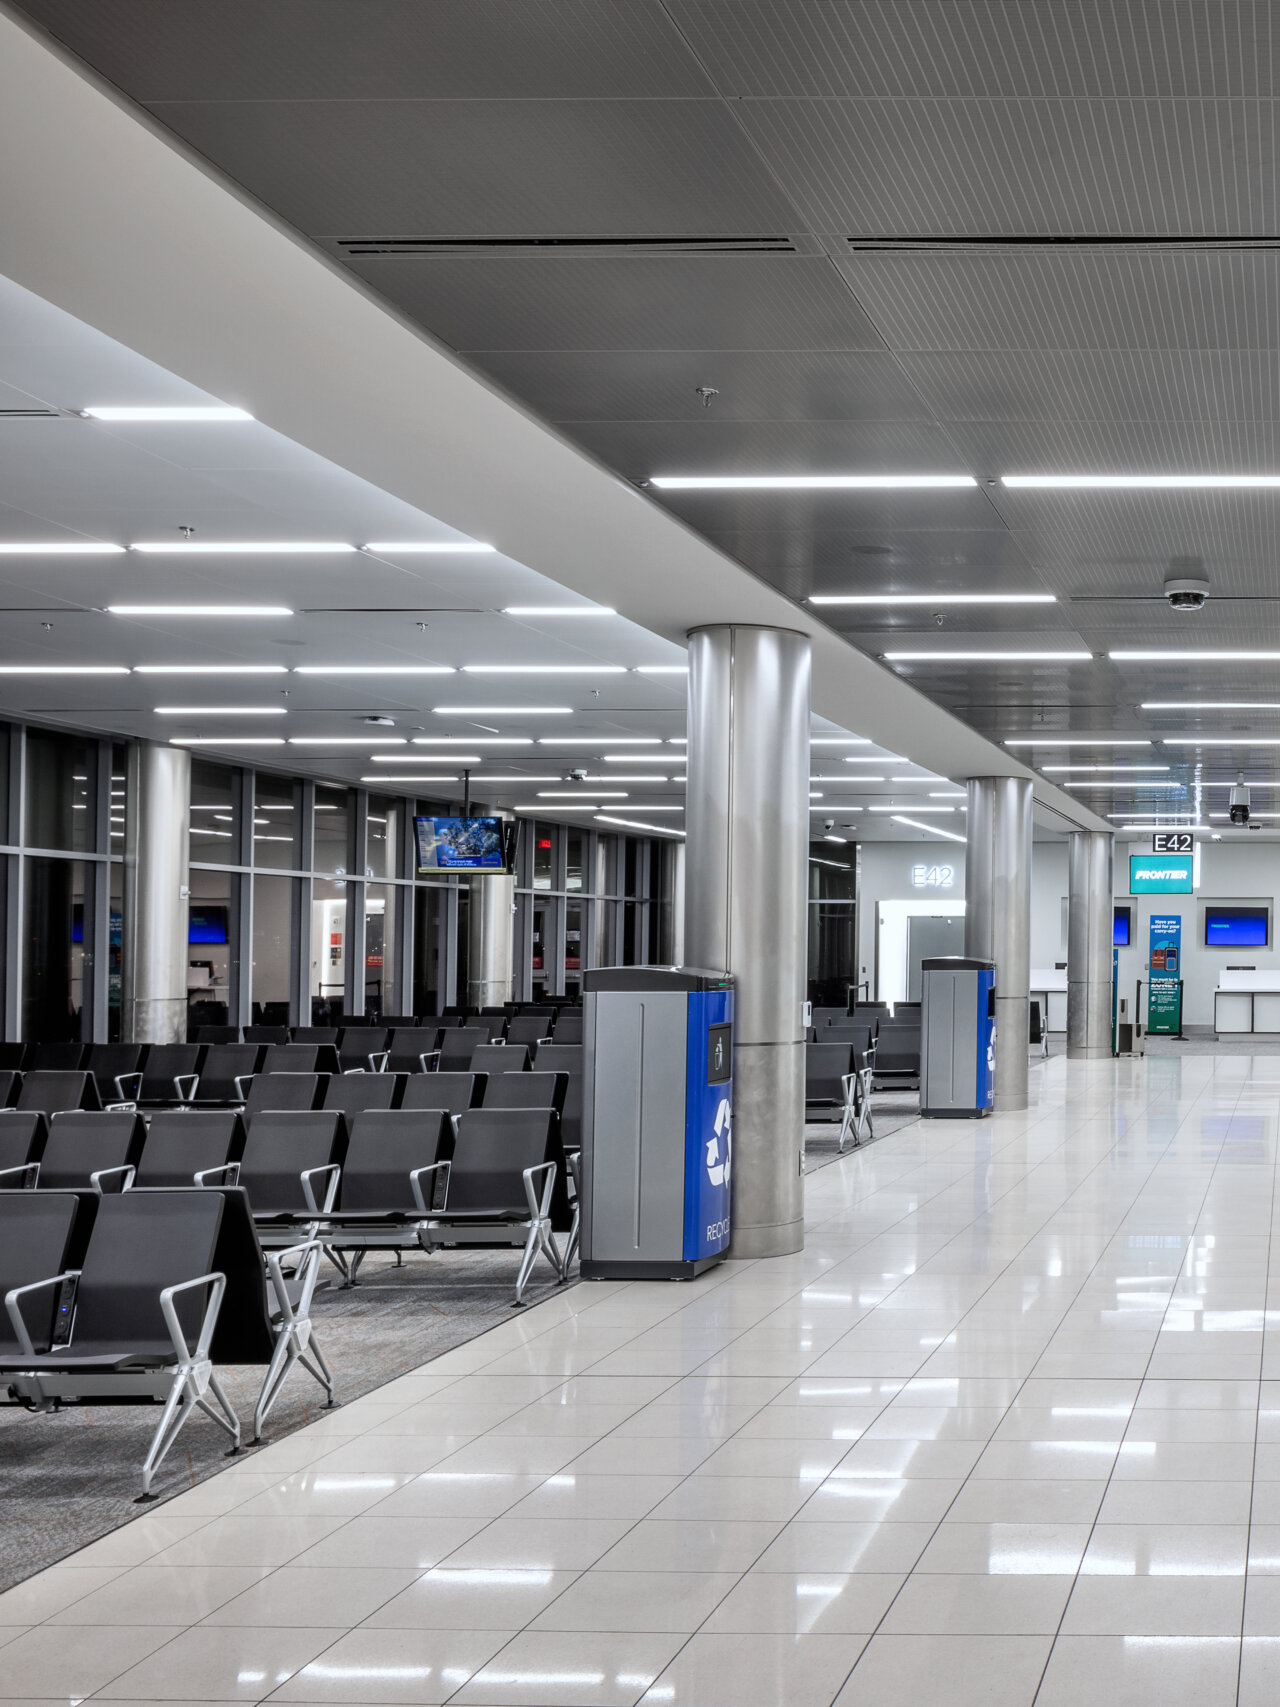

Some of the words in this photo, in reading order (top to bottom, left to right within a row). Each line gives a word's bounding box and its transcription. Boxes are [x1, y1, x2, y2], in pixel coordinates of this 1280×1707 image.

[1155, 834, 1192, 851] E42
[913, 866, 952, 885] E42
[1135, 870, 1188, 880] FRONTIER
